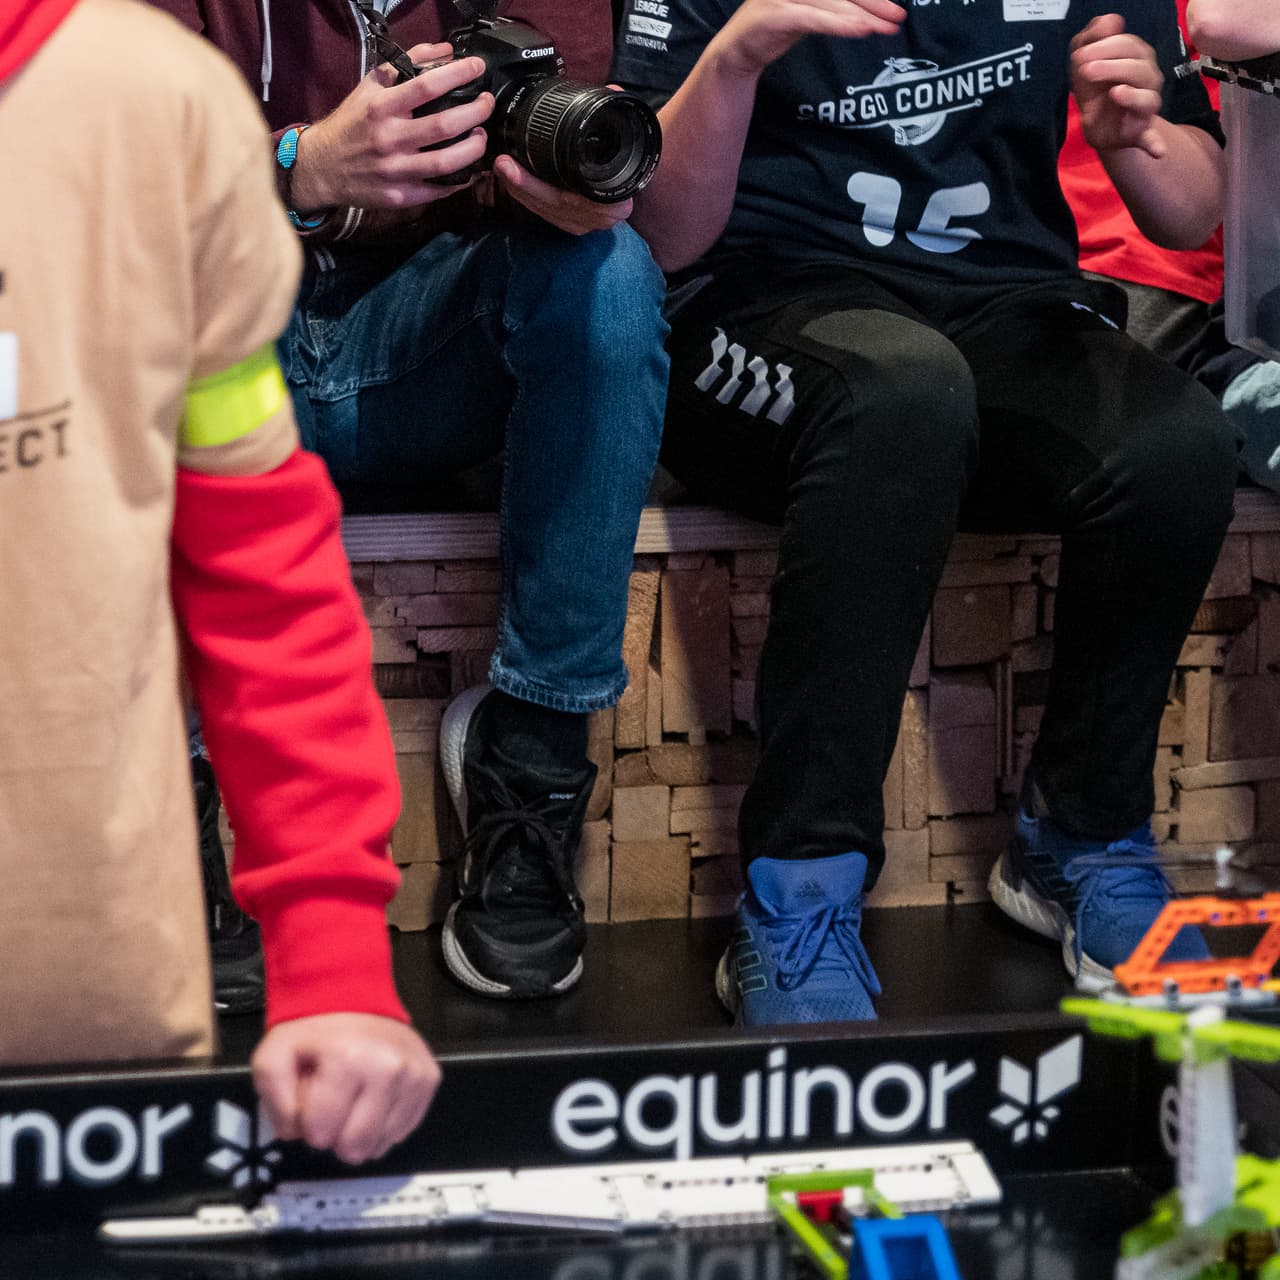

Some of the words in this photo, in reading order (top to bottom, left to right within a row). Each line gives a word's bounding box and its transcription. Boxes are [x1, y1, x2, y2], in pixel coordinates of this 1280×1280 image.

[633, 0, 670, 18] LEAGUE
[521, 46, 555, 59] Canon
[895, 55, 1032, 112] CONNECT
[552, 1047, 977, 1161] equinor
